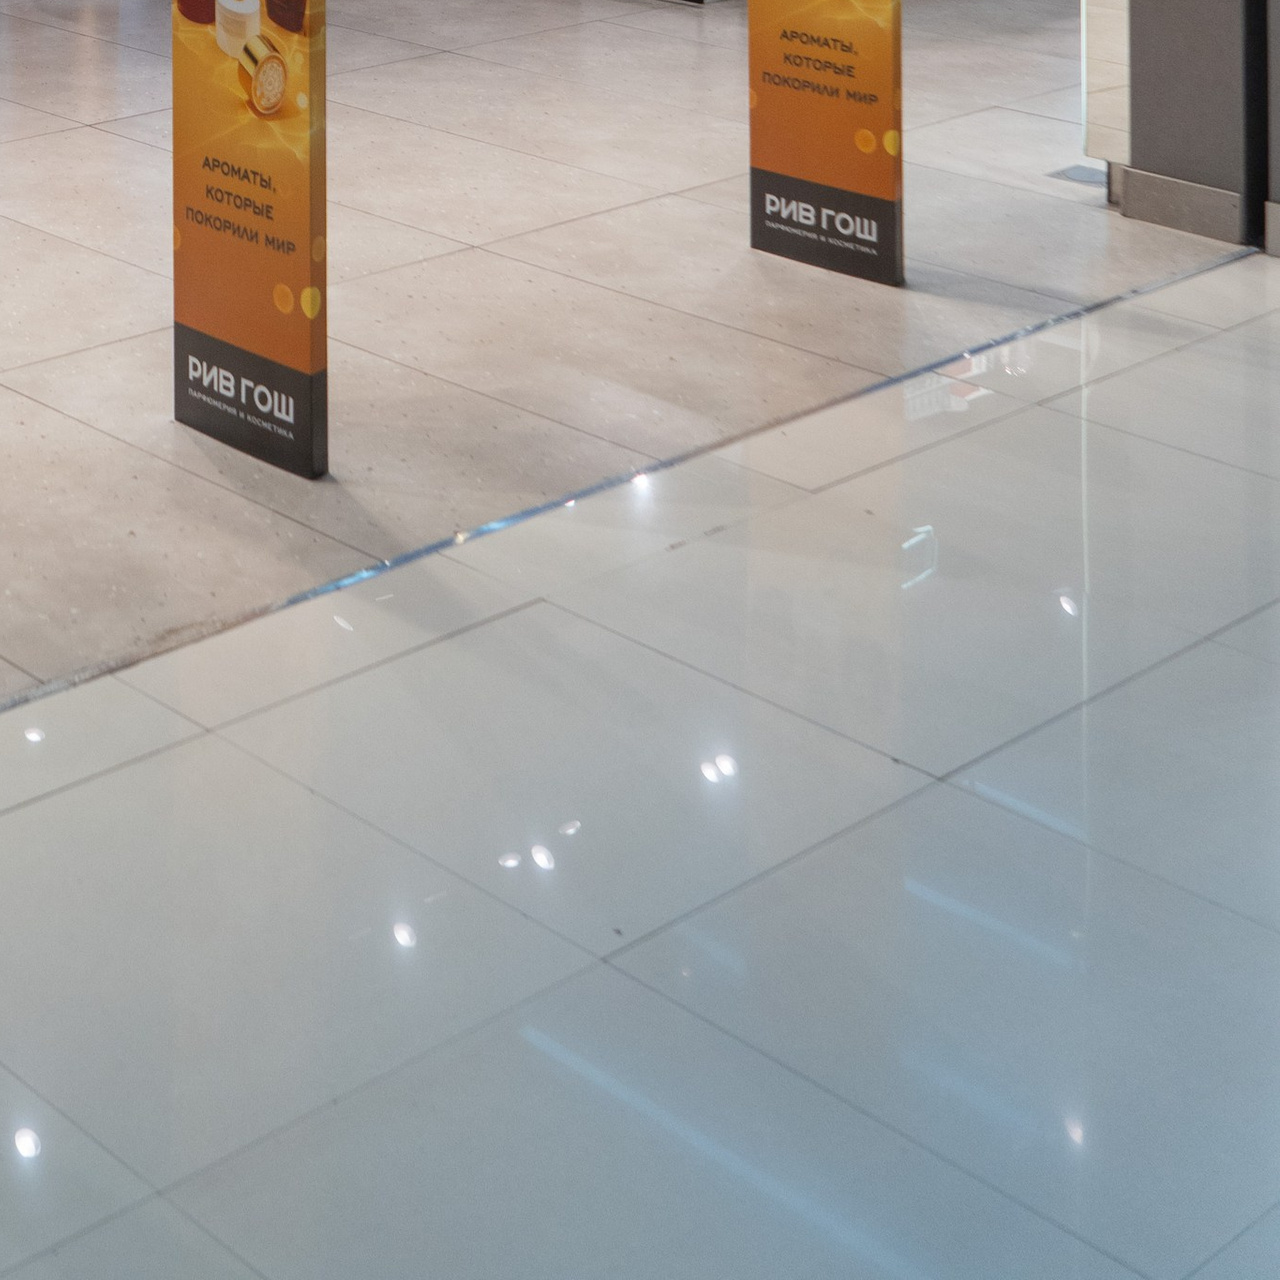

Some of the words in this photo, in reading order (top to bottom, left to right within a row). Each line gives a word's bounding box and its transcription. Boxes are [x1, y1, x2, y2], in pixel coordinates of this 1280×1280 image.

[780, 28, 858, 56] АРОМАТЫ,
[783, 52, 855, 78] КОТОРЫЕ
[762, 70, 839, 99] ПОКОРИЛИ
[846, 90, 878, 106] МИР
[202, 156, 276, 192] АРОМАТЫ,
[205, 184, 274, 220] КОТОРЫЕ
[765, 193, 816, 225] РИВ
[821, 207, 878, 242] ГОШ
[185, 206, 259, 245] ПОКОРИЛИ
[264, 234, 296, 256] МИР
[765, 219, 818, 241] ПАРФЮМЕРИЯ
[828, 237, 878, 255] КОСМЕТИКА
[188, 355, 235, 398] РИВ
[240, 377, 295, 425] ГОШ
[188, 388, 237, 416] ПАРФЮМЕРИЯ
[246, 413, 295, 440] КОСМЕТИКА
